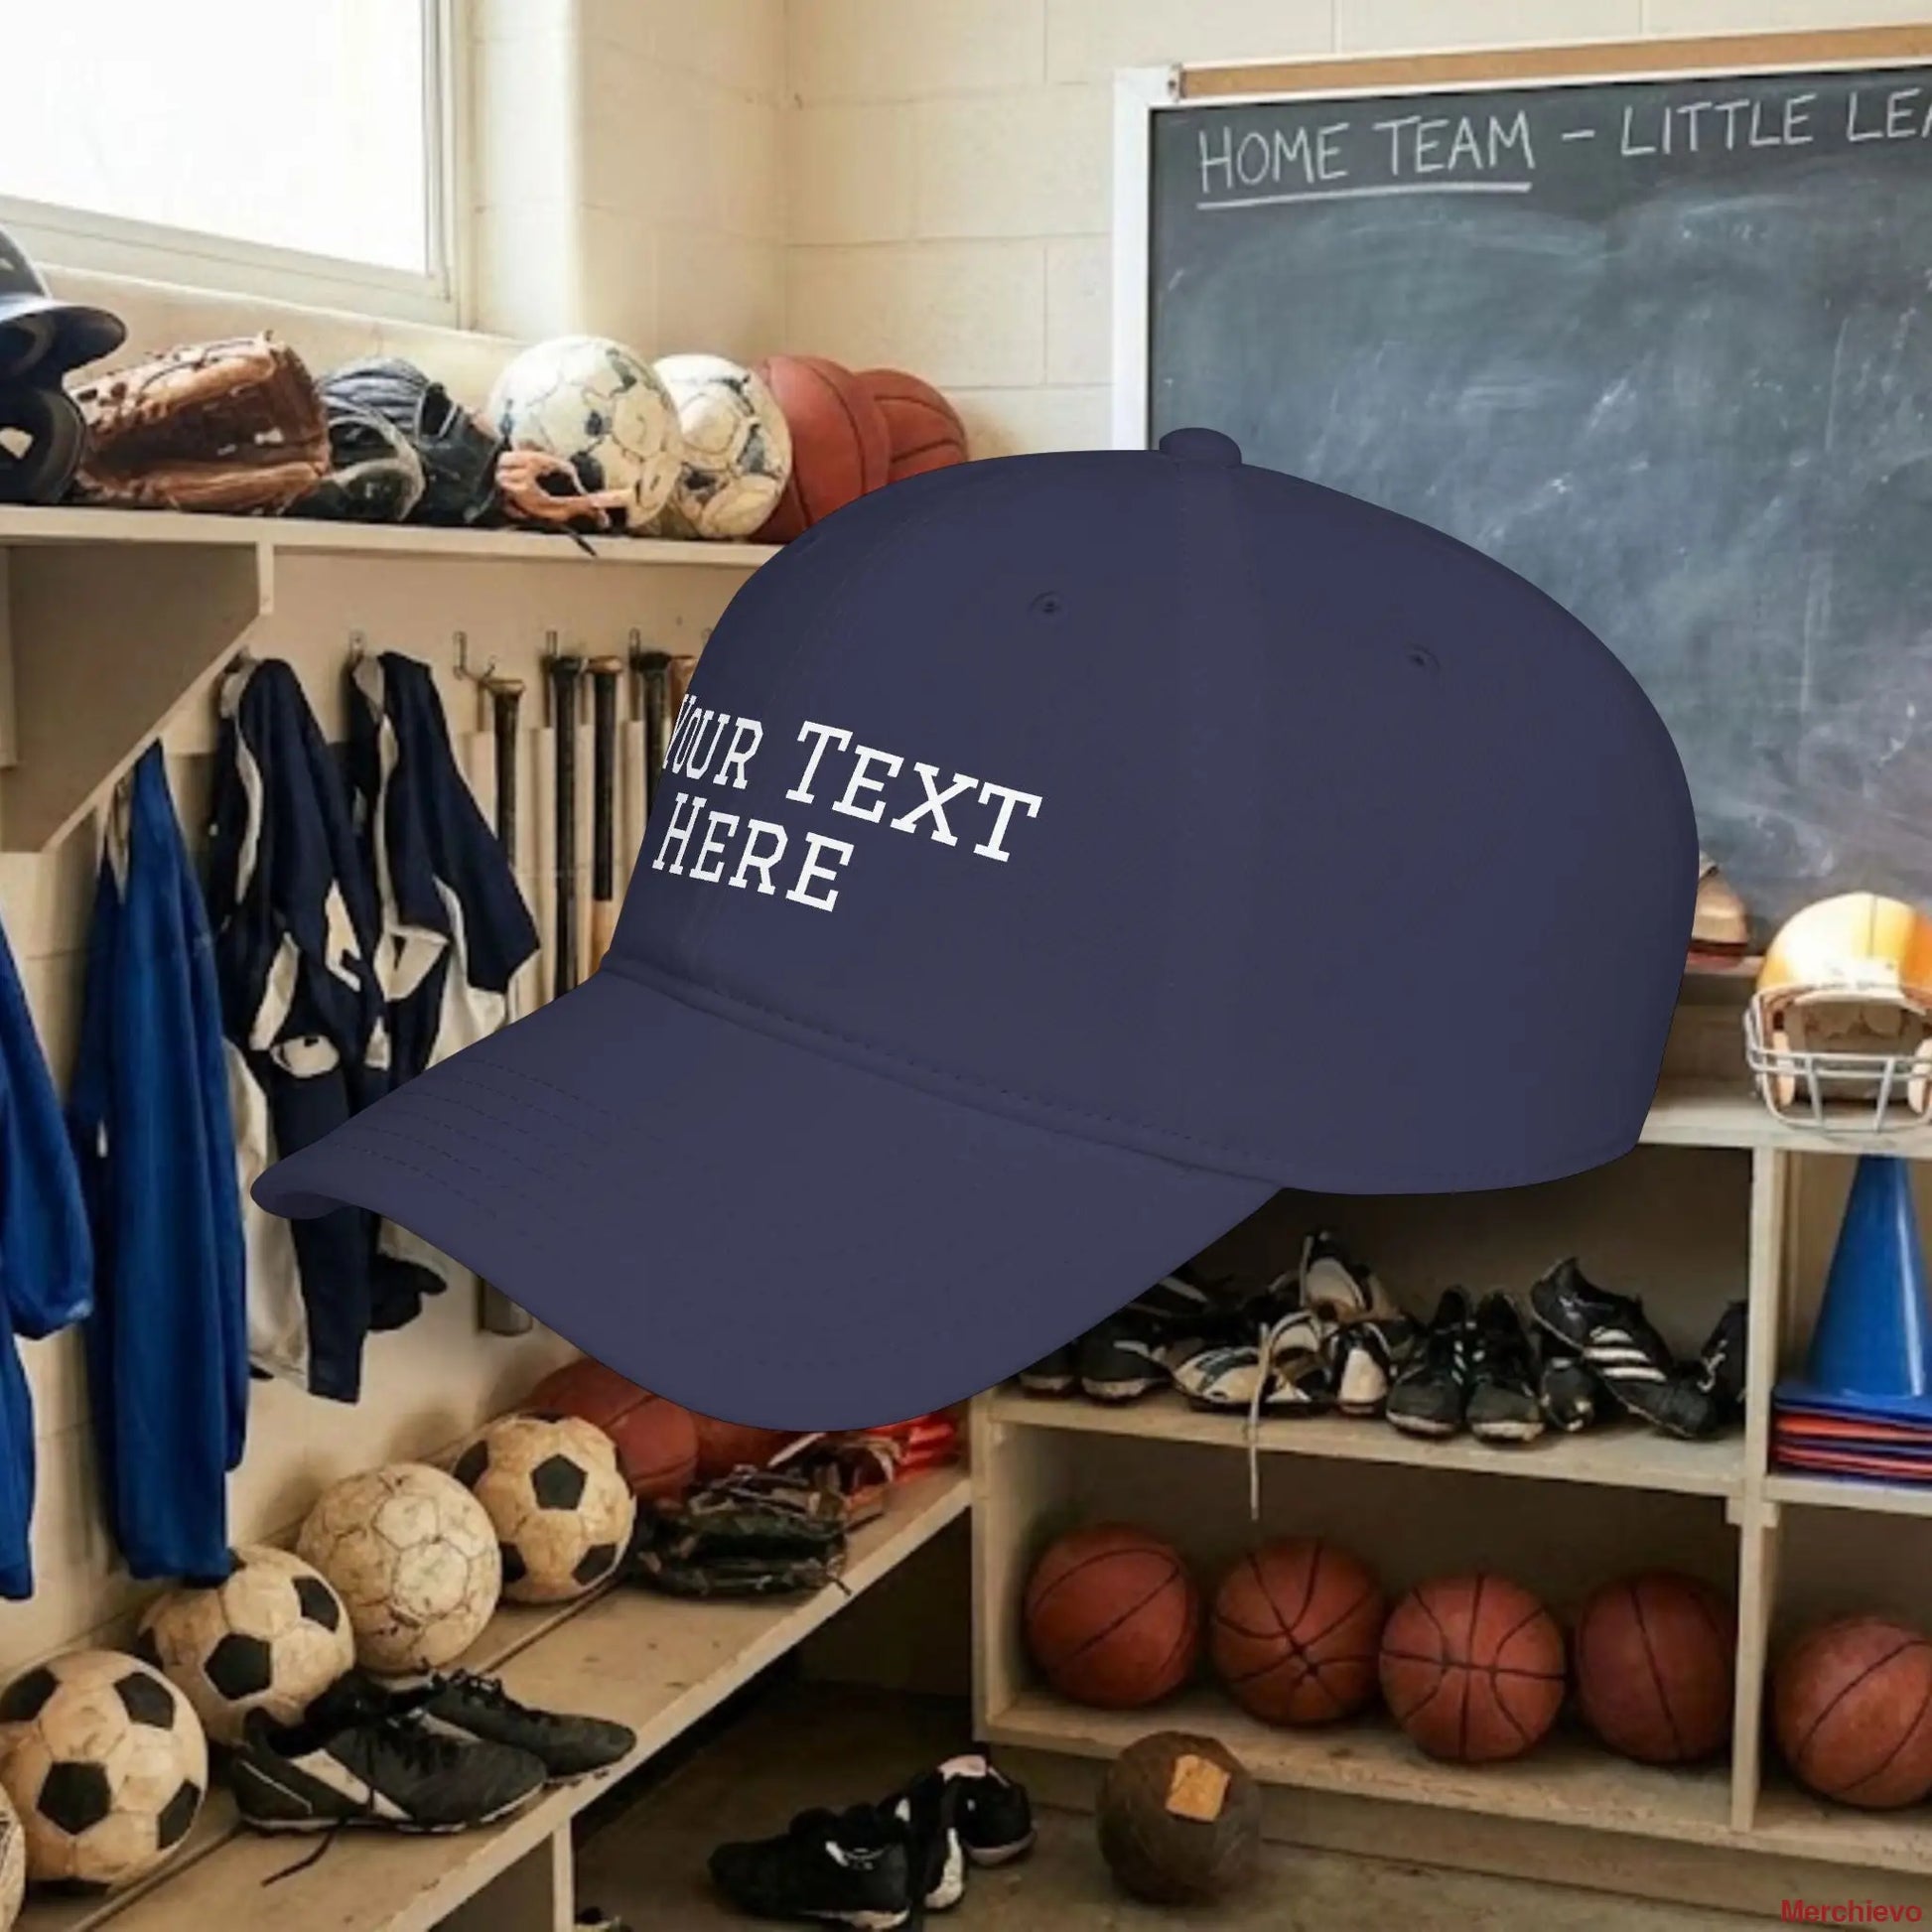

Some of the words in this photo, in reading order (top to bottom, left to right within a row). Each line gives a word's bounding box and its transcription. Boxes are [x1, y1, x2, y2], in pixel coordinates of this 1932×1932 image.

[1197, 123, 1348, 193] HOME
[1372, 110, 1536, 176] TEAM
[1620, 94, 1817, 157] LITTLE
[662, 694, 763, 789] YOUR
[785, 721, 1043, 863] TEXT
[651, 792, 855, 912] HERE
